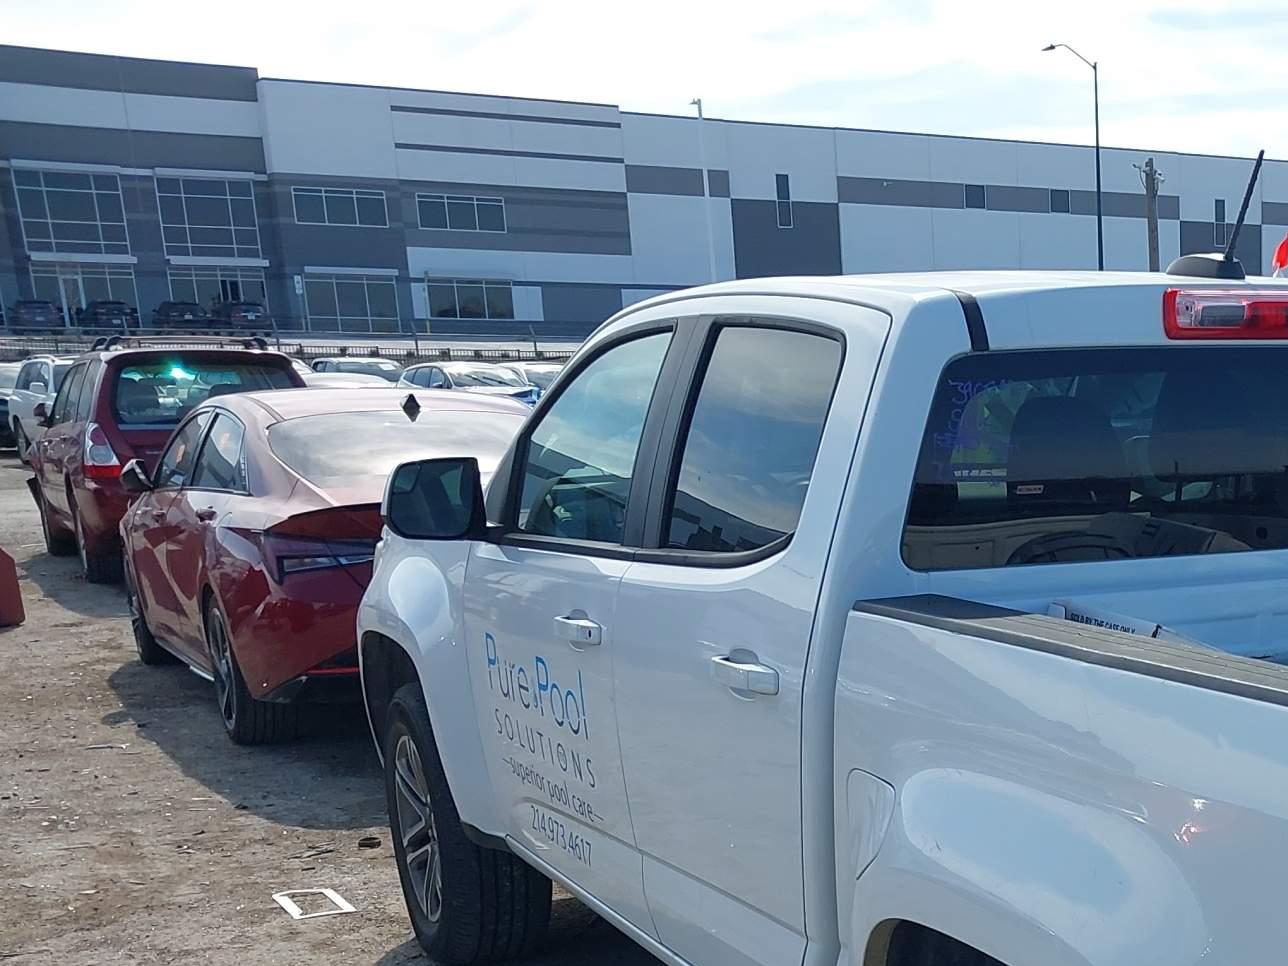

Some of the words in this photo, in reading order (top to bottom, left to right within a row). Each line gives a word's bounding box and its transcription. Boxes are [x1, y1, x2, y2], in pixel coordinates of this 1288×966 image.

[484, 632, 531, 710] Pure
[535, 655, 589, 742] Pool
[494, 708, 596, 789] SOLUTIONS
[530, 804, 592, 868] 214.973.4617
[547, 779, 571, 808] pool
[571, 795, 595, 823] care
